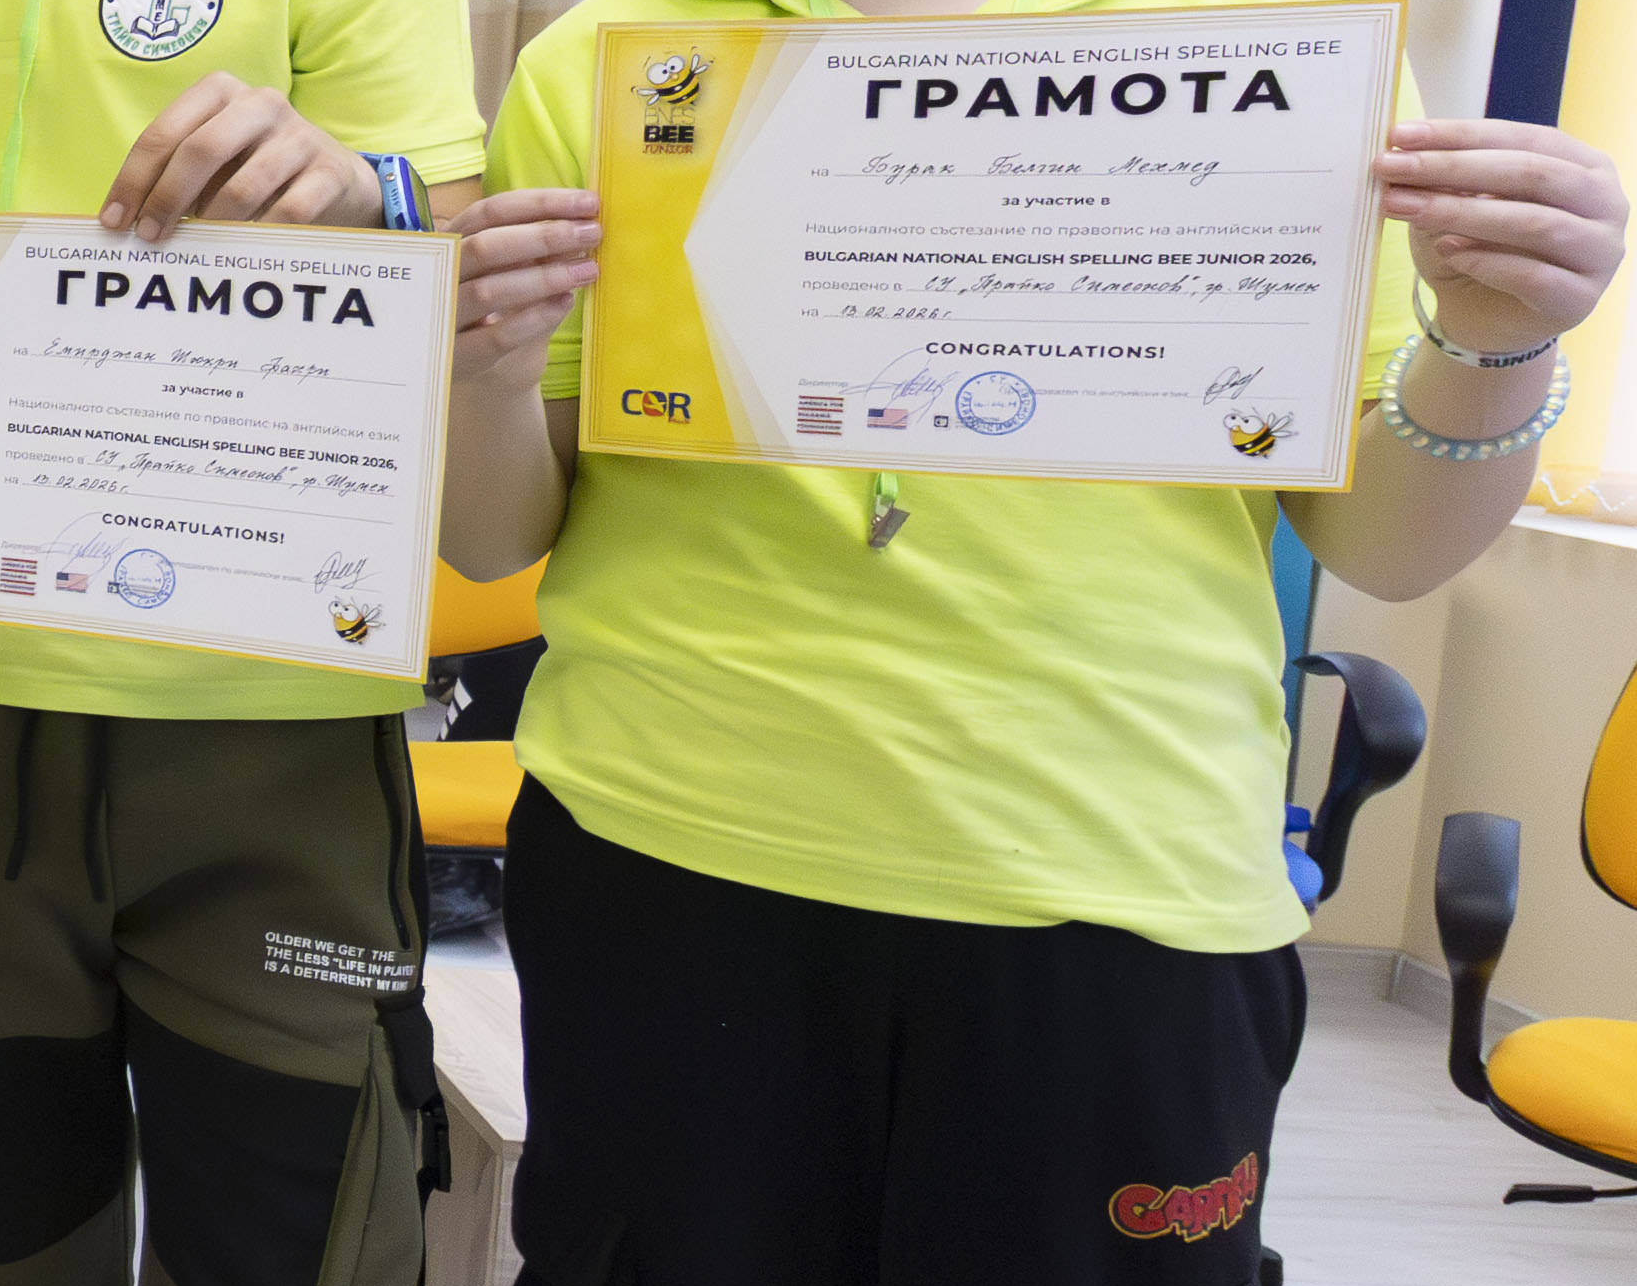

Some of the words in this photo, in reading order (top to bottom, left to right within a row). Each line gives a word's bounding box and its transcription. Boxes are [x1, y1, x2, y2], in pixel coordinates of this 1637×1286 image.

[827, 54, 947, 68] BULGARIAN
[956, 50, 1065, 65] NATIONAL
[1073, 46, 1168, 62] ENGLISH
[1177, 42, 1287, 59] SPELLING
[1296, 40, 1341, 55] BEE
[865, 69, 1290, 118] ГРАМОТА
[644, 125, 694, 144] BEE
[811, 168, 829, 177] на
[1002, 197, 1019, 205] за
[1024, 197, 1094, 207] участие
[1101, 197, 1109, 205] в
[805, 222, 925, 234] Националното
[929, 226, 1025, 235] състезание
[1031, 226, 1052, 235] по
[1058, 226, 1144, 237] правопис
[1149, 226, 1170, 235] на
[1175, 223, 1272, 235] английски
[1278, 225, 1321, 234] език
[25, 246, 121, 260] BULGARIAN
[128, 249, 210, 268] NATIONAL
[214, 255, 286, 272] ENGLISH
[290, 260, 370, 277] SPELLING
[377, 265, 410, 279] BEE
[804, 251, 897, 262] BULGARIAN
[903, 253, 987, 263] NATIONAL
[992, 253, 1064, 264] ENGLISH
[1069, 254, 1152, 264] SPELLING
[1158, 254, 1192, 264] BEE
[1196, 253, 1264, 264] JUNIOR
[1269, 253, 1316, 265] 2026,
[56, 269, 373, 326] ГРАМОТА
[802, 280, 888, 292] проведено
[894, 282, 903, 291] в
[801, 308, 819, 317] на
[926, 342, 1164, 358] CONGRATULATIONS!
[7, 423, 81, 437] BULGARIAN
[85, 429, 150, 443] NATIONAL
[153, 435, 208, 449] ENGLISH
[212, 441, 275, 455] SPELLING
[279, 447, 304, 459] BEE
[307, 450, 358, 464] JUNIOR
[361, 456, 397, 470] 2026,
[102, 513, 284, 543] CONGRATULATIONS!
[265, 931, 311, 949] OLDER
[314, 940, 335, 953] WE
[338, 944, 365, 958] GET
[371, 950, 395, 962] THE
[264, 960, 278, 972] IS
[280, 964, 290, 975] A
[294, 965, 373, 988] DETERRENT
[265, 946, 292, 960] THE
[295, 951, 329, 966] LESS
[368, 964, 381, 976] IN
